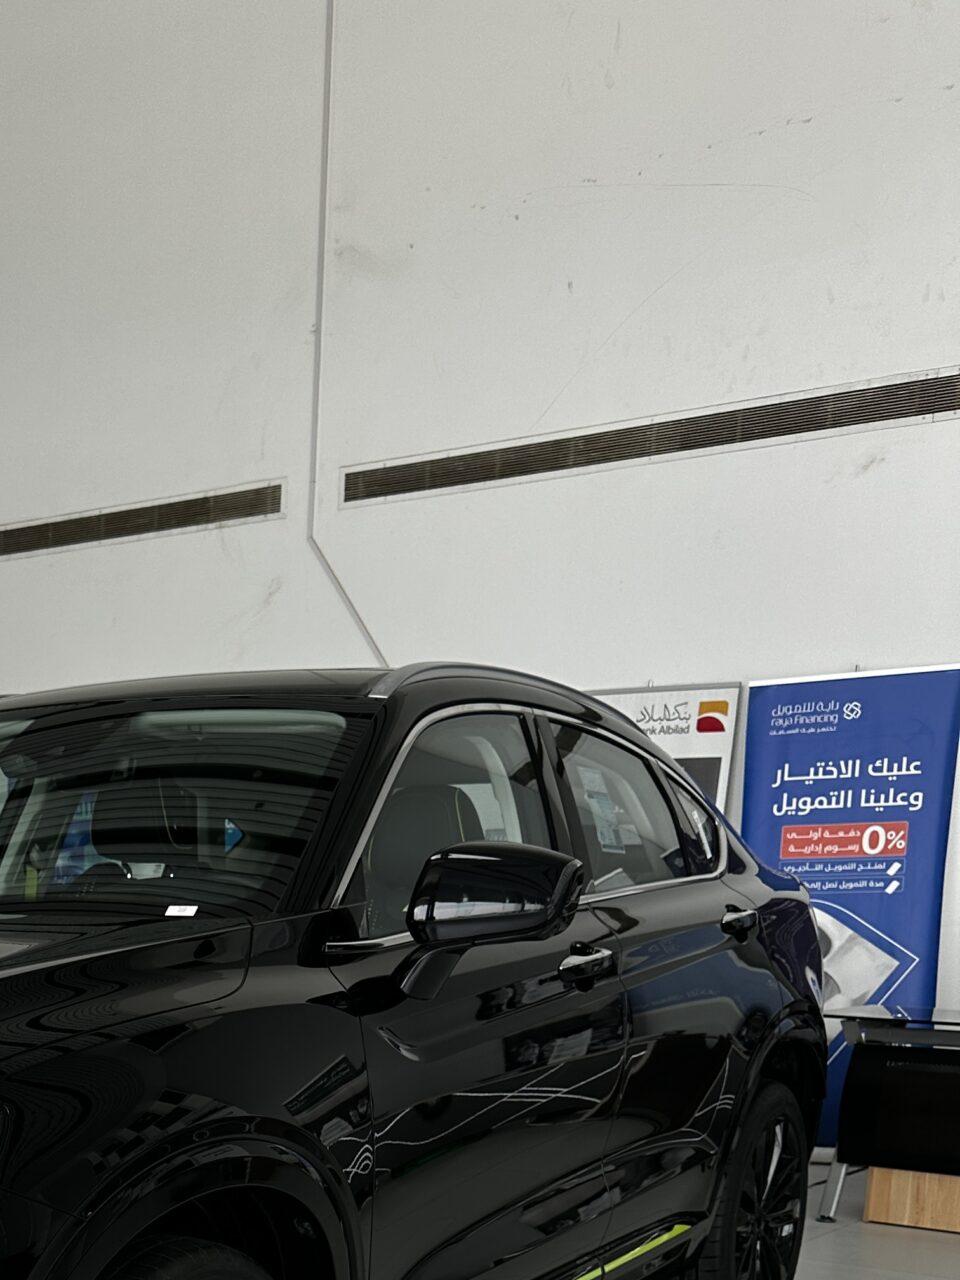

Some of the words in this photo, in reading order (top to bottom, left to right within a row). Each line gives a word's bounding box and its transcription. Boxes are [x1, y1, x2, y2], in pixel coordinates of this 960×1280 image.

[658, 724, 690, 735] Albilad
[867, 756, 922, 781] عليك
[772, 789, 853, 816] التمويل
[860, 787, 924, 812] وعلينا
[861, 825, 906, 855] 0%
[825, 863, 856, 872] التمويل
[839, 880, 867, 889] التمويل
